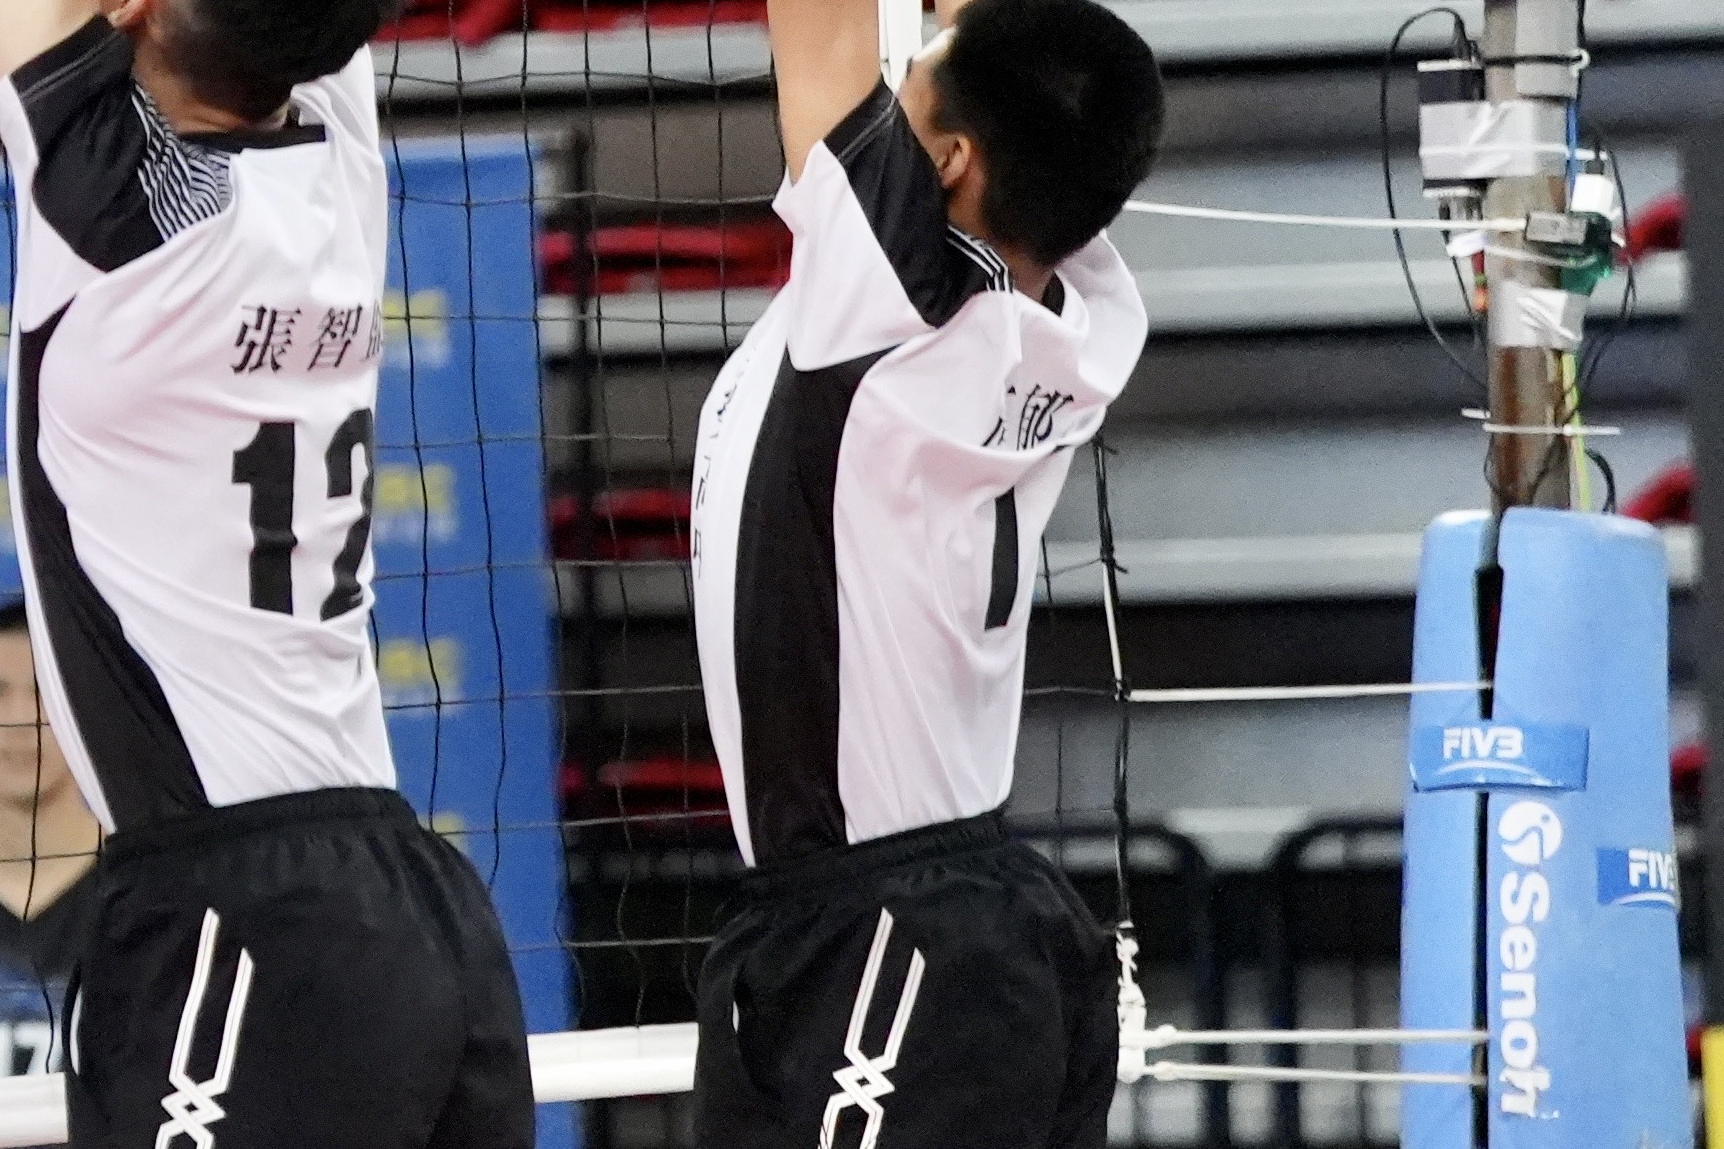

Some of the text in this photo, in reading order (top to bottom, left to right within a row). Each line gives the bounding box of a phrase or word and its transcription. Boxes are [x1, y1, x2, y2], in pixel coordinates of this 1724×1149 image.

[231, 407, 375, 622] 12
[1628, 848, 1676, 891] FIV
[1498, 871, 1552, 1118] Senoh
